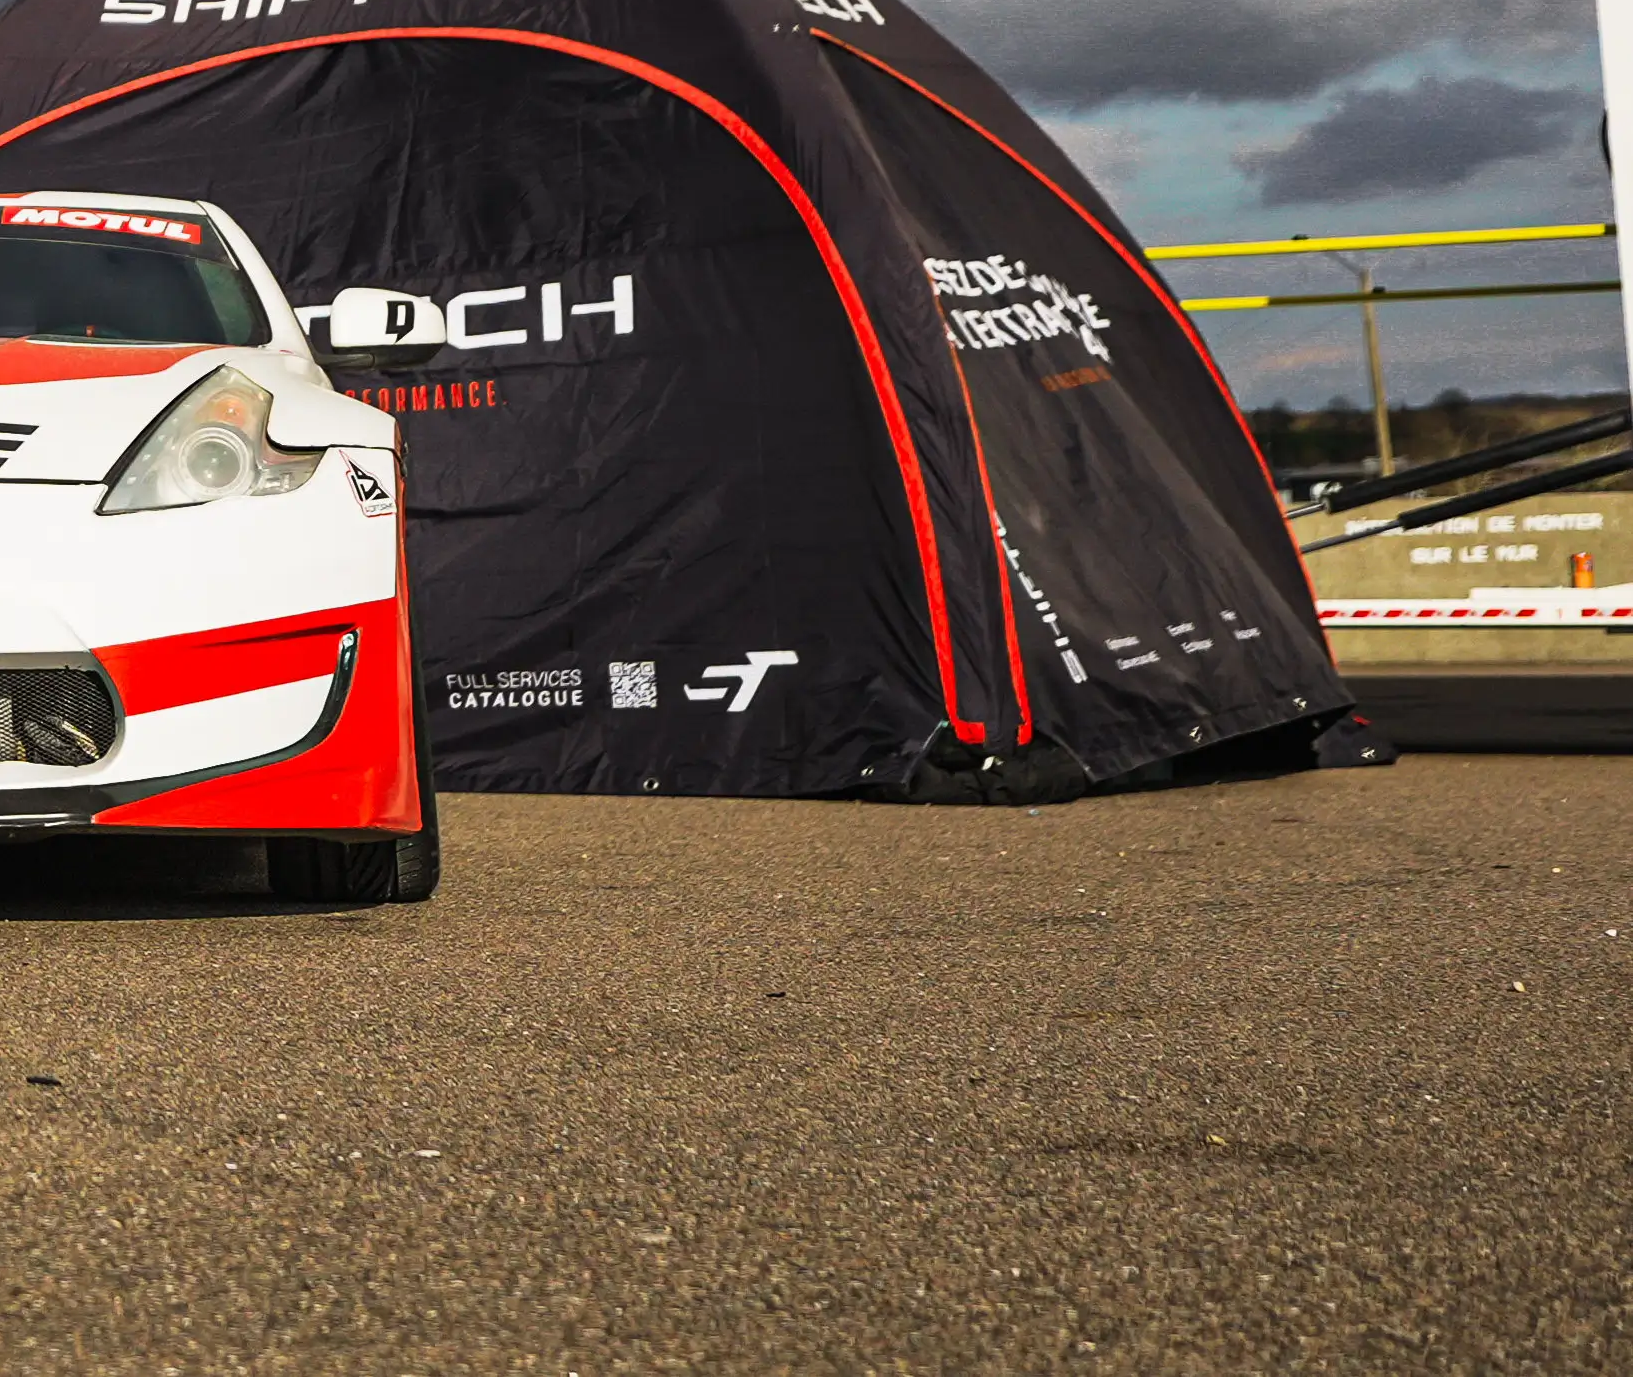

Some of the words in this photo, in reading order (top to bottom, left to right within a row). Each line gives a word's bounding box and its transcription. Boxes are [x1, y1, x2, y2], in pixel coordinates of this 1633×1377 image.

[10, 208, 192, 240] MOTUL
[446, 673, 495, 690] FULL
[496, 669, 583, 689] SERVICES
[448, 690, 585, 709] CATALOGUE
